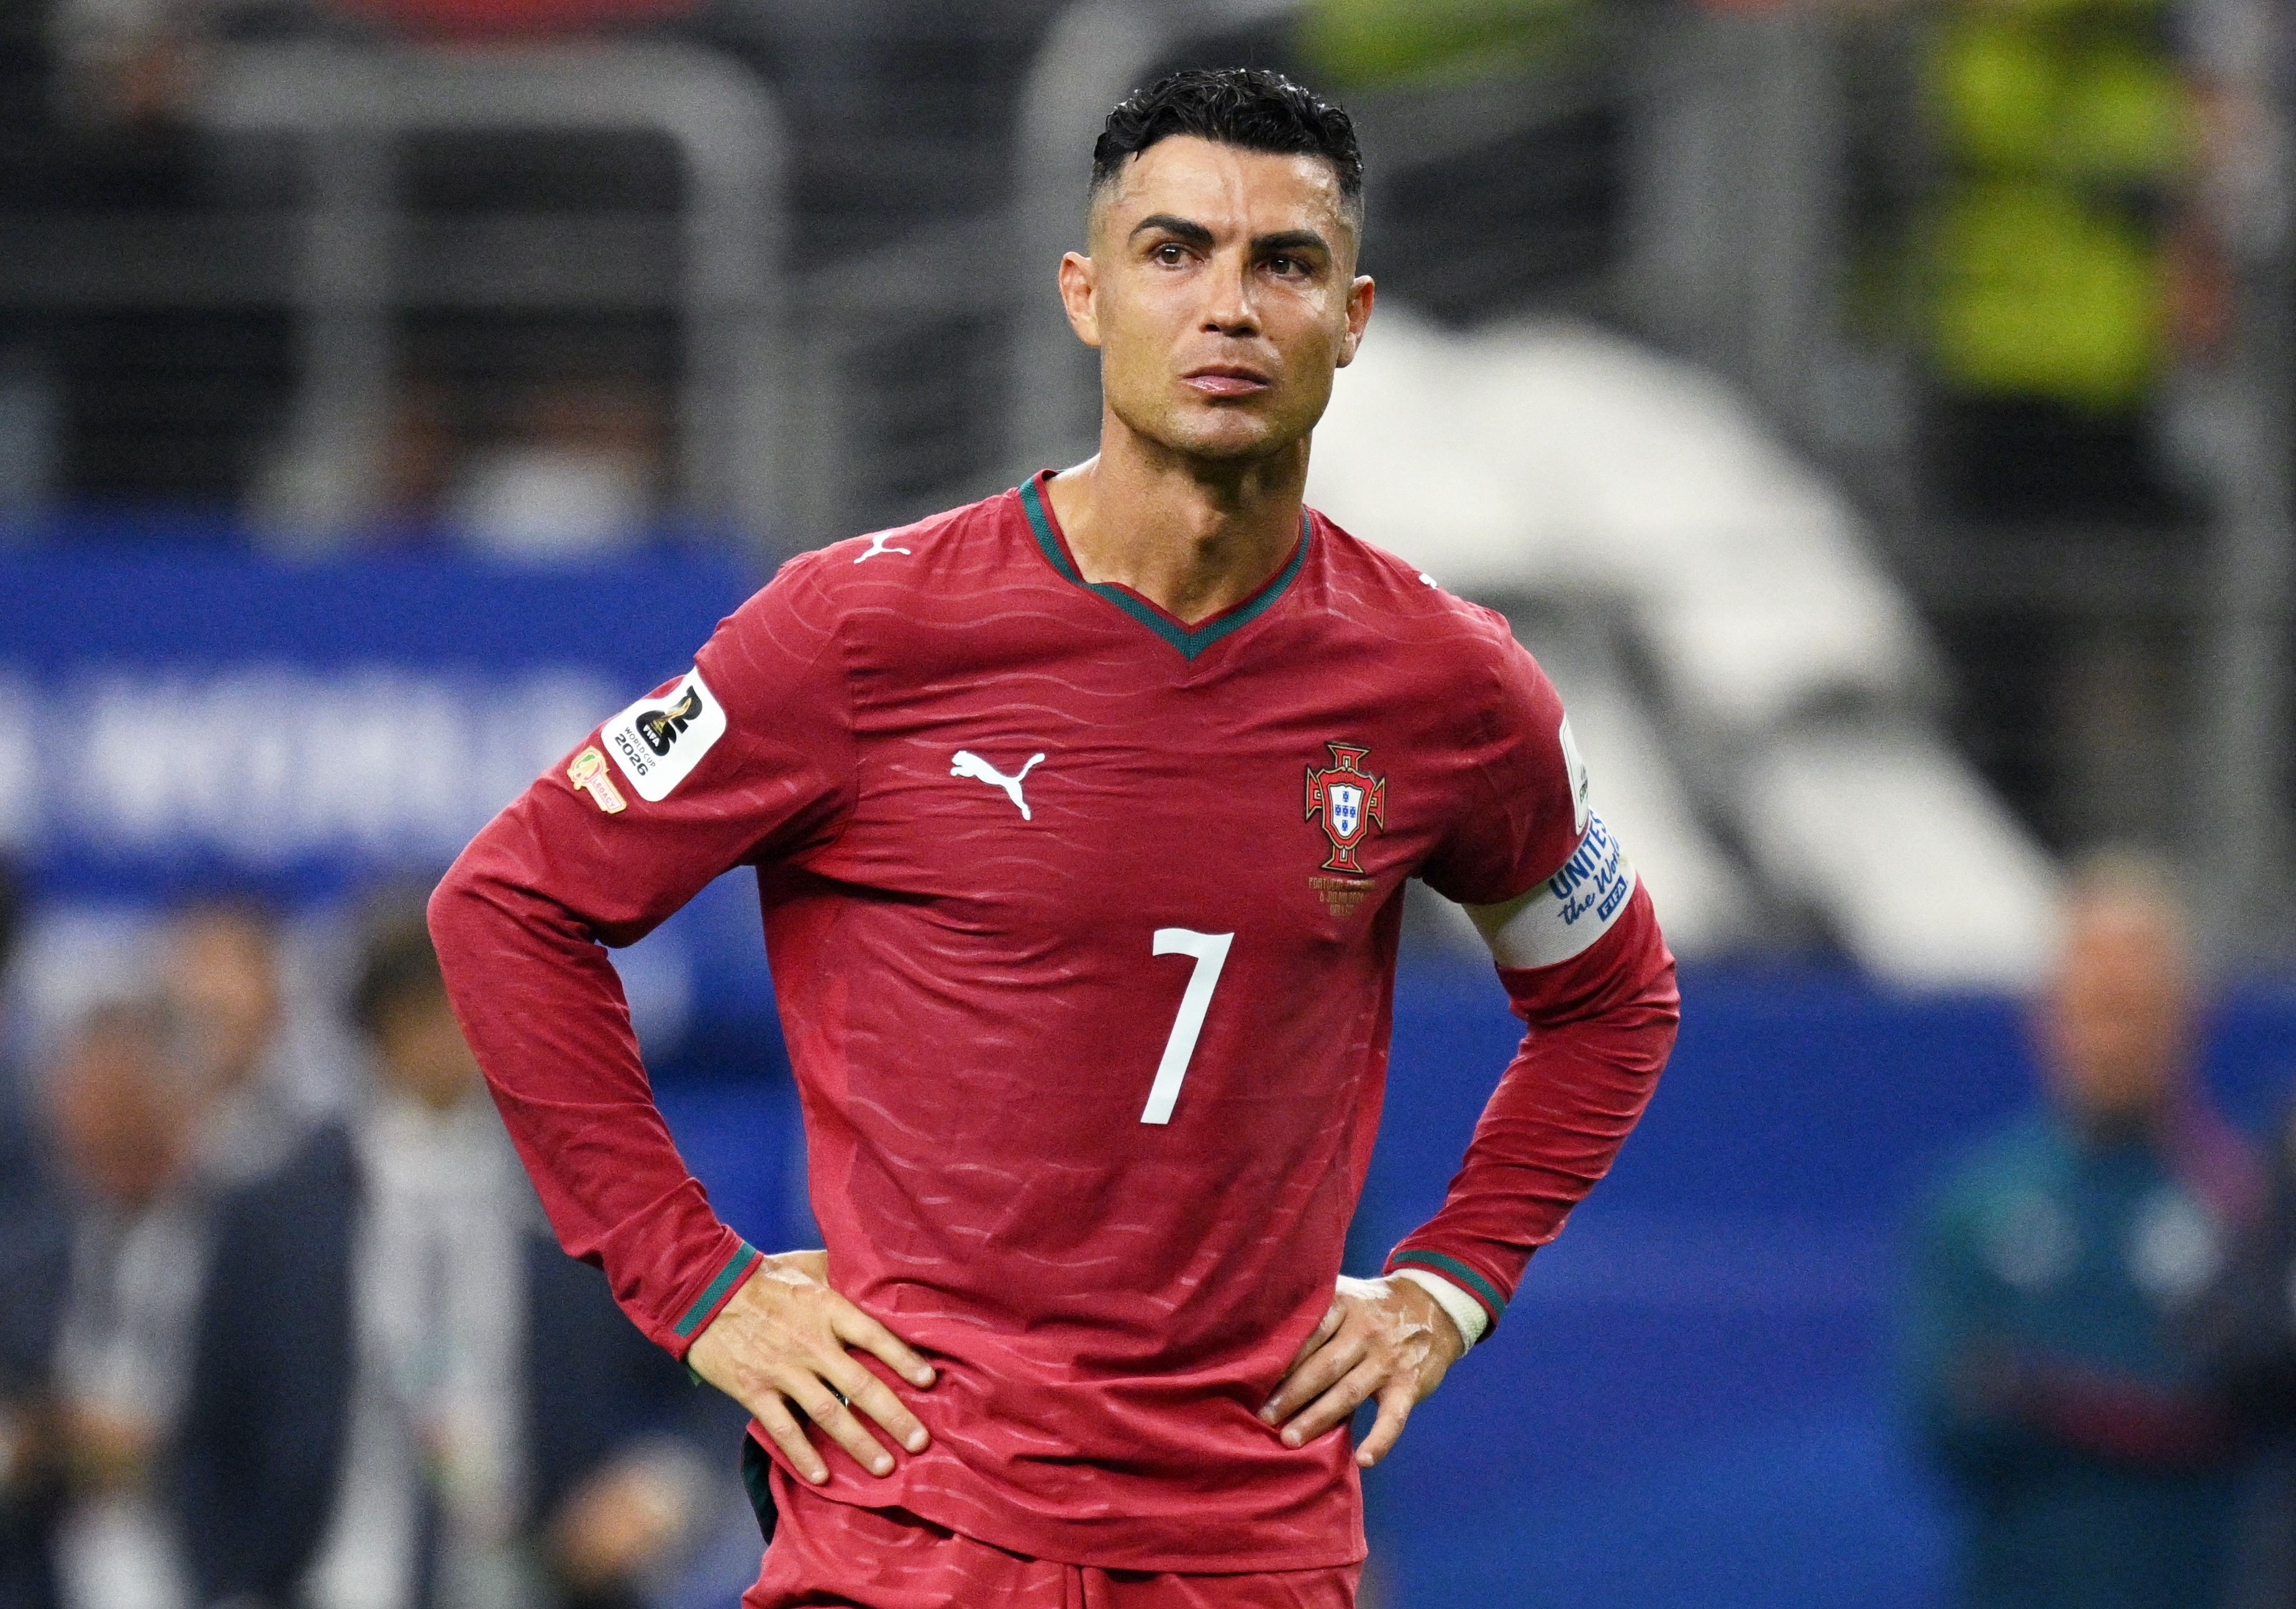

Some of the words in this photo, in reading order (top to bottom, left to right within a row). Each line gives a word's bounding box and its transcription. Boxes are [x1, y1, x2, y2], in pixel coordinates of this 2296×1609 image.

[614, 733, 648, 776] 2026
[625, 726, 645, 753] WORLD
[643, 753, 656, 767] CUP
[643, 724, 660, 747] FIFA
[593, 778, 615, 807] LEGACY
[1548, 809, 1607, 900] UNITES
[1558, 892, 1595, 925] the
[1599, 880, 1626, 919] FIFA
[1140, 928, 1235, 1125] 7
